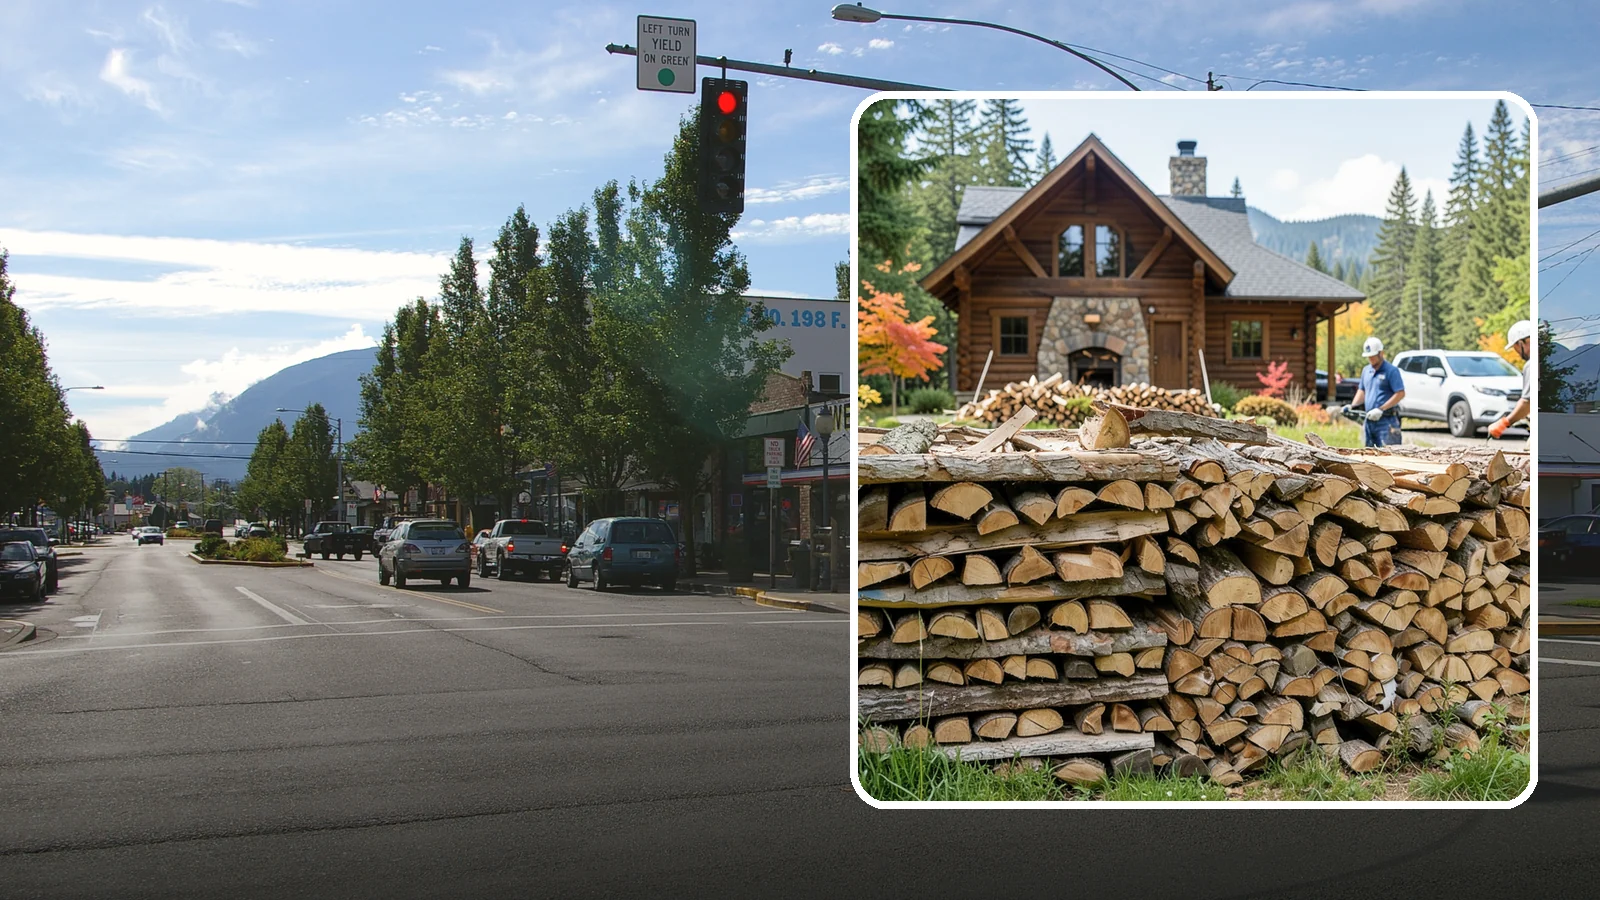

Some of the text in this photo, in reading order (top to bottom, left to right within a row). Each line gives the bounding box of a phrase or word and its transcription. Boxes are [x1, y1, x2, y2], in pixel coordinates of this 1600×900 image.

[643, 24, 690, 36] LEFT TURN
[652, 38, 682, 51] YIELD
[644, 54, 688, 66] ON GREEN
[791, 309, 826, 328] 198
[831, 312, 846, 329] F.
